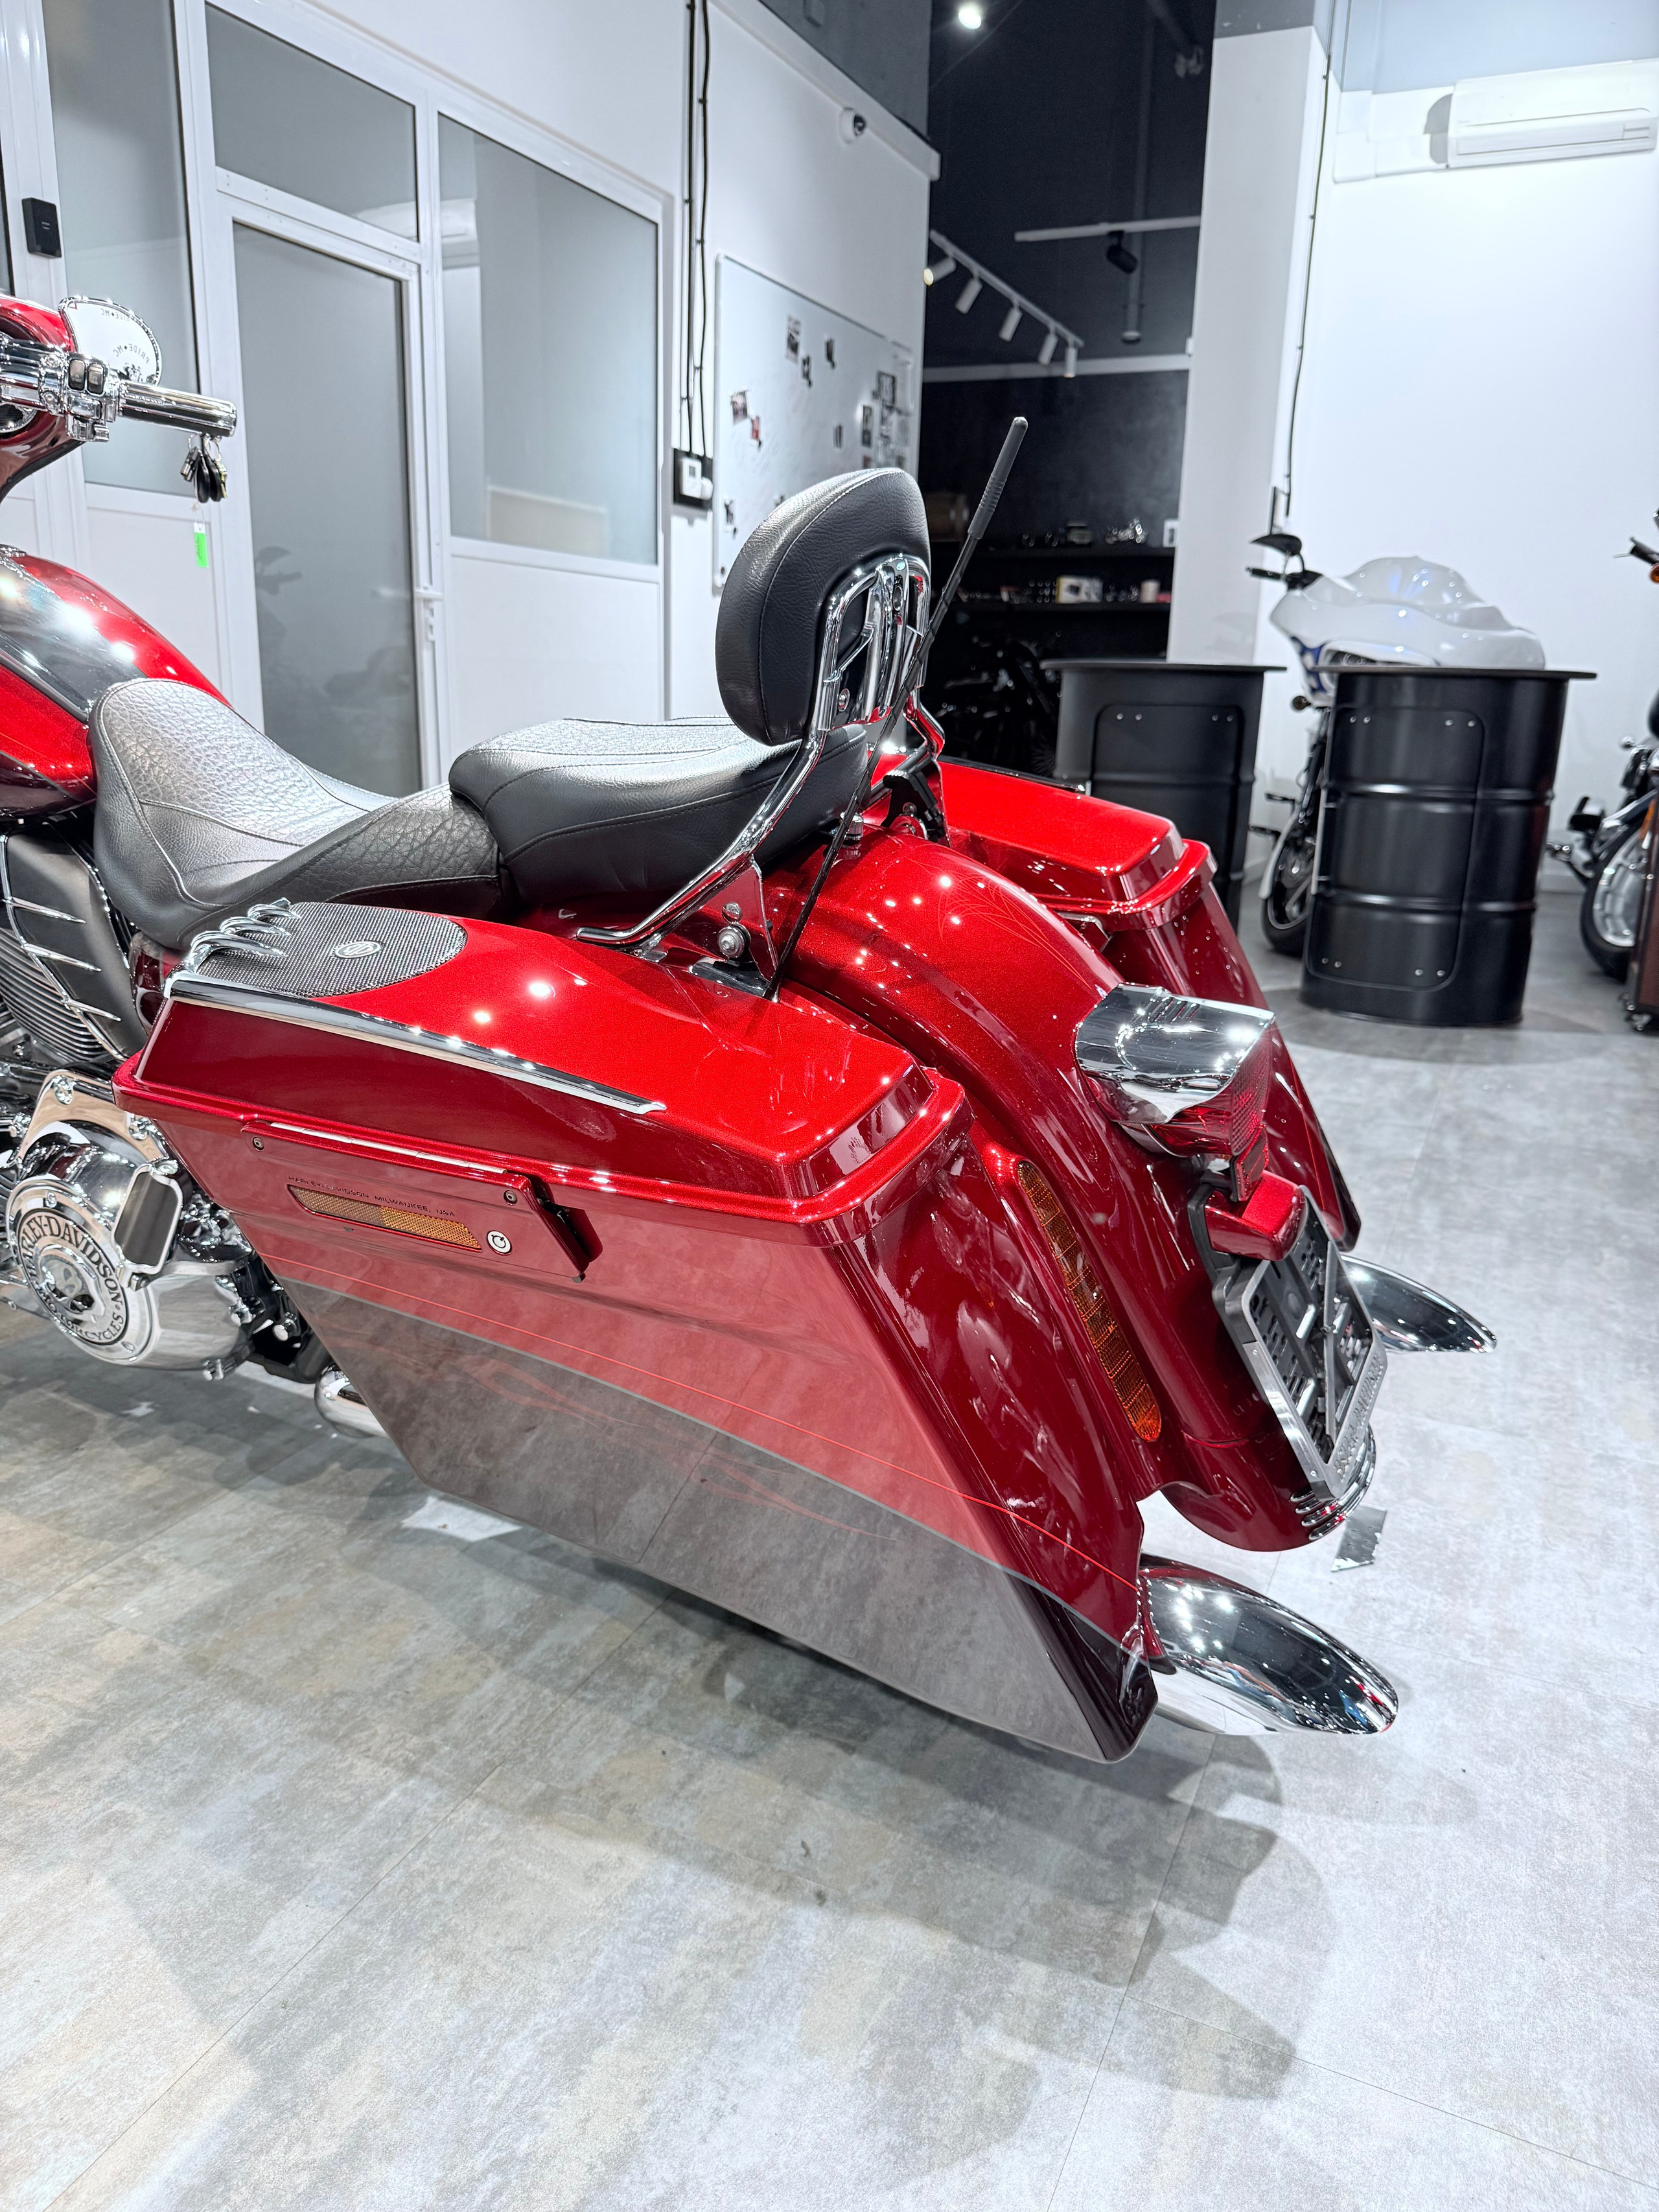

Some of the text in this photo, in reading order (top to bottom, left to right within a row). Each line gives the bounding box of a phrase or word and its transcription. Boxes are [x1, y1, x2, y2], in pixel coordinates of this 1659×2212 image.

[288, 1176, 456, 1217] HARLEY-DAVIDSON MILWAUKEE, USA
[21, 1215, 124, 1306] HARLEY-DAVIDSON
